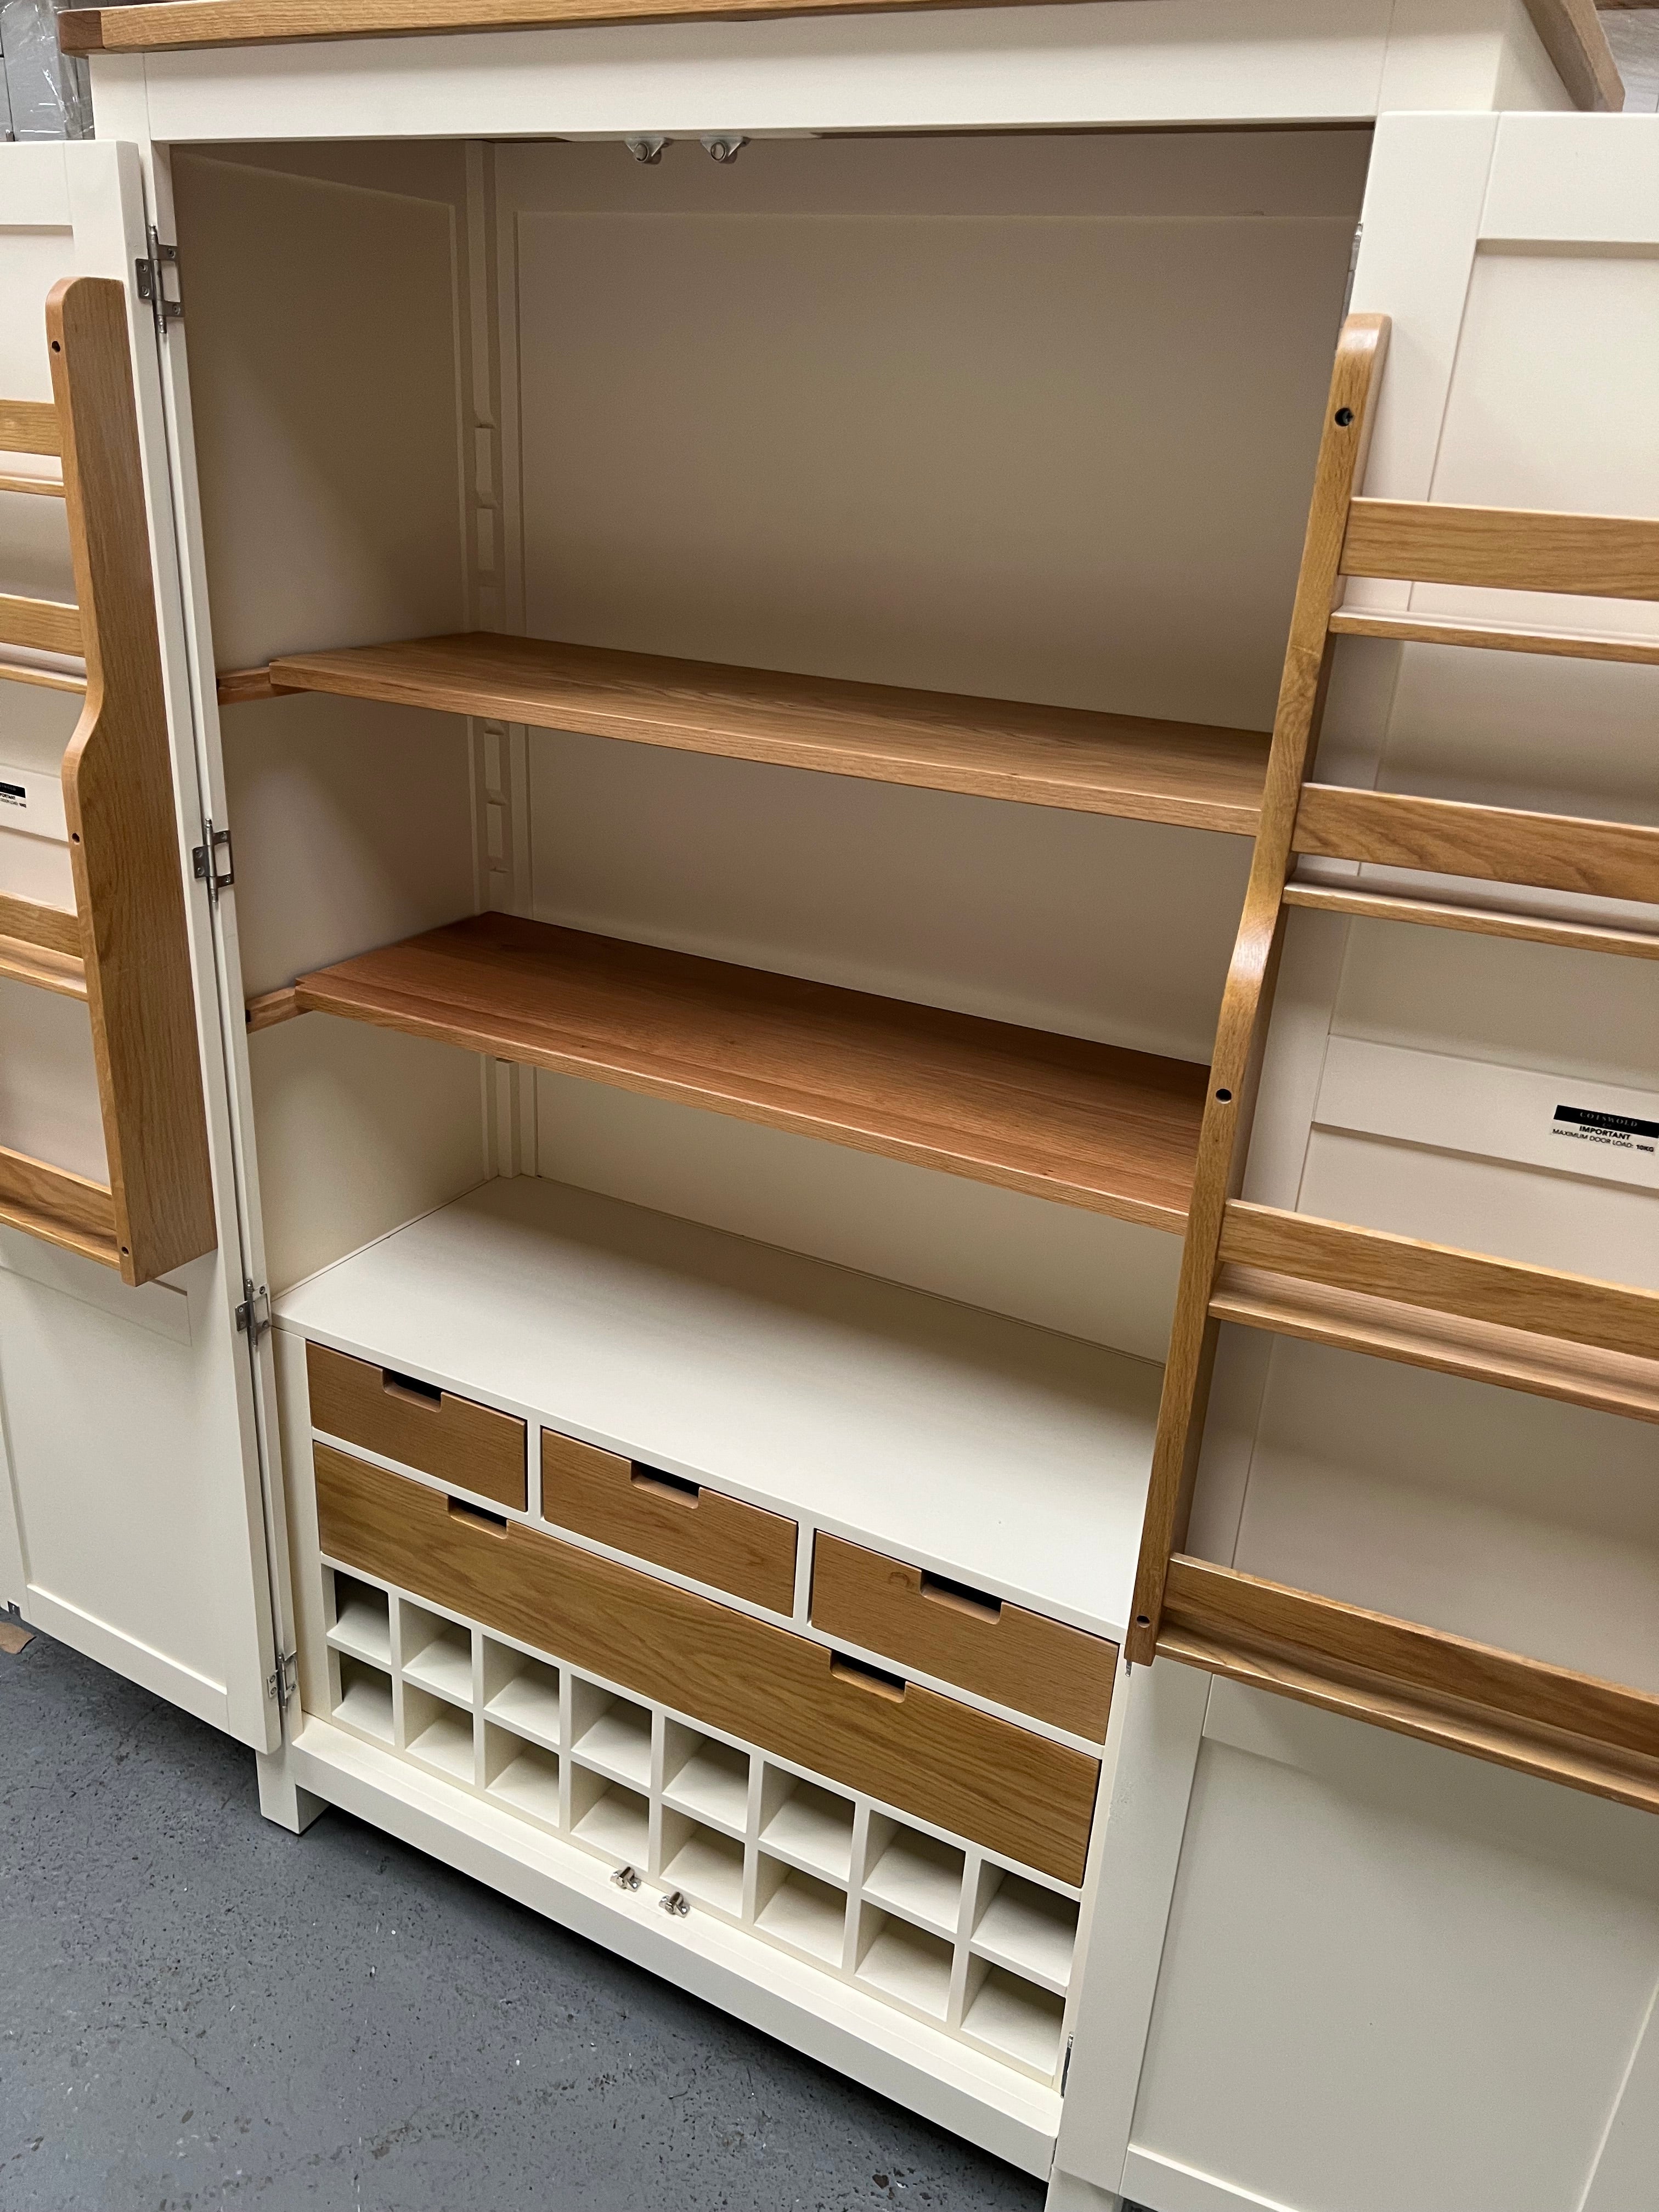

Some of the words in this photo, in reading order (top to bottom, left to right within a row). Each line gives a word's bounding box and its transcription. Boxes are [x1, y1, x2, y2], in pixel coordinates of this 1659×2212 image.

[1579, 1111, 1638, 1127] COTSWOLD
[1552, 1128, 1588, 1139] MAXIMUM
[1589, 1135, 1611, 1144] DOOR
[1612, 1139, 1633, 1148] LOAD:
[1579, 1125, 1630, 1140] IMPORTANT
